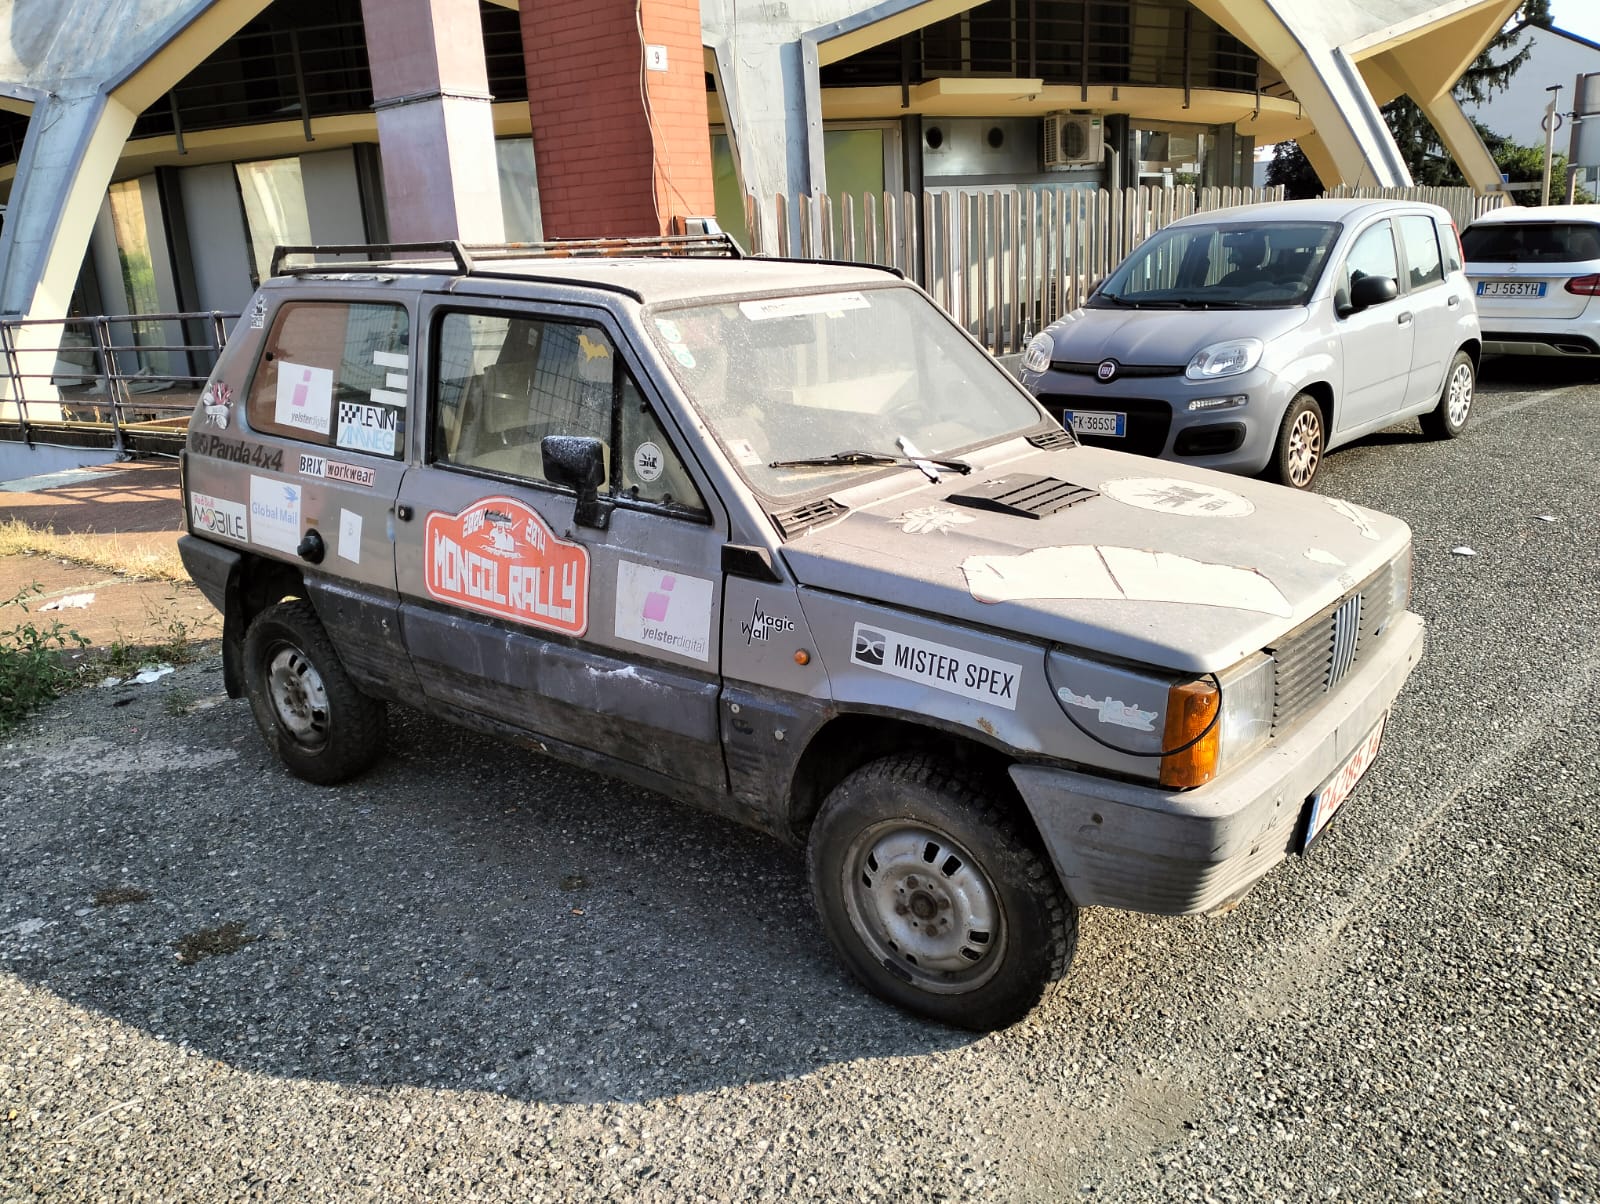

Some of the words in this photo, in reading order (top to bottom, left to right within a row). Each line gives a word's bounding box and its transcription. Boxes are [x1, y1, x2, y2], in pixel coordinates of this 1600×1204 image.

[654, 51, 660, 64] 9
[291, 411, 329, 428] yelsterdigital
[361, 407, 396, 431] LEVIN
[209, 436, 251, 465] Panda
[251, 445, 284, 472] 4x4
[299, 456, 323, 476] BRIX
[327, 464, 373, 484] workwear
[193, 505, 246, 540] MOBILE
[252, 502, 278, 520] Global
[280, 508, 297, 525] Mail
[434, 529, 508, 605] MONGOL
[509, 560, 577, 624] RALLY
[752, 599, 794, 632] Magic
[641, 628, 706, 654] yelsterdigital
[741, 621, 769, 645] Wall
[894, 643, 960, 684] MISTER
[964, 663, 1015, 699] SPEX
